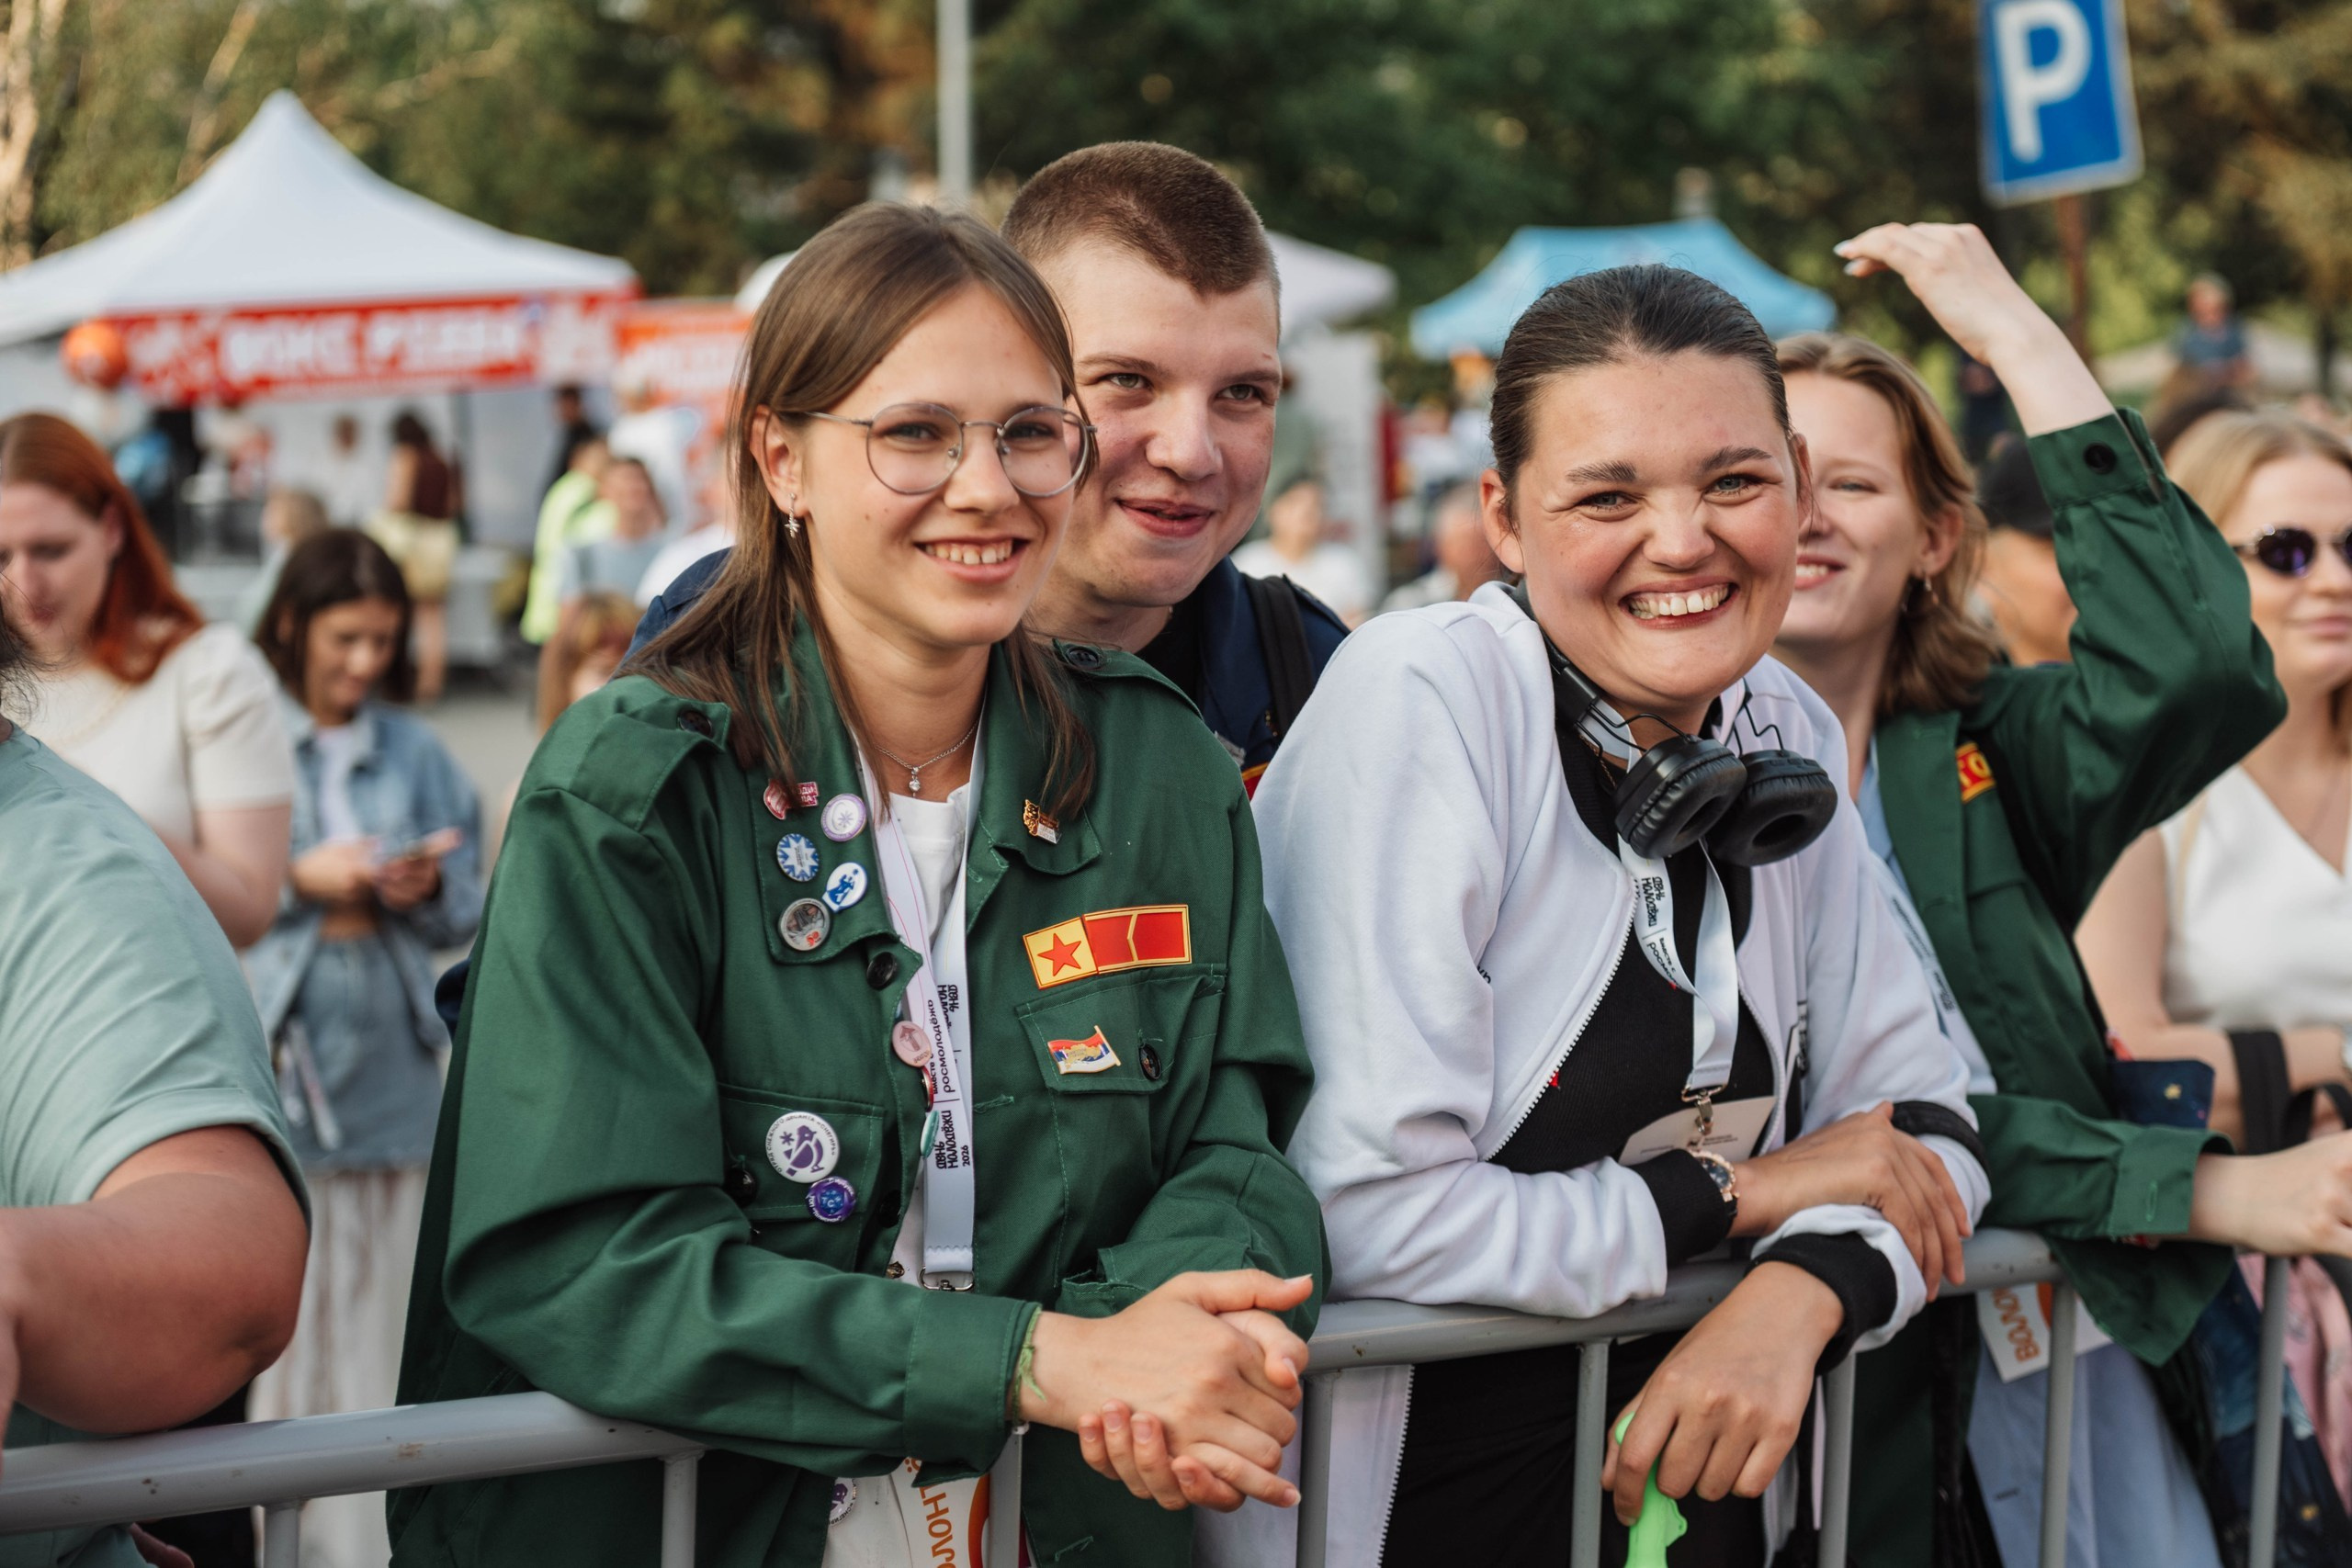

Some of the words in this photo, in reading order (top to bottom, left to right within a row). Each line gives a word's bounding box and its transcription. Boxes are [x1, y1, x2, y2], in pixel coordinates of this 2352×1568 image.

[1992, 0, 2093, 164] P
[927, 999, 956, 1093] росмолодёжь
[961, 1145, 970, 1167] 2026
